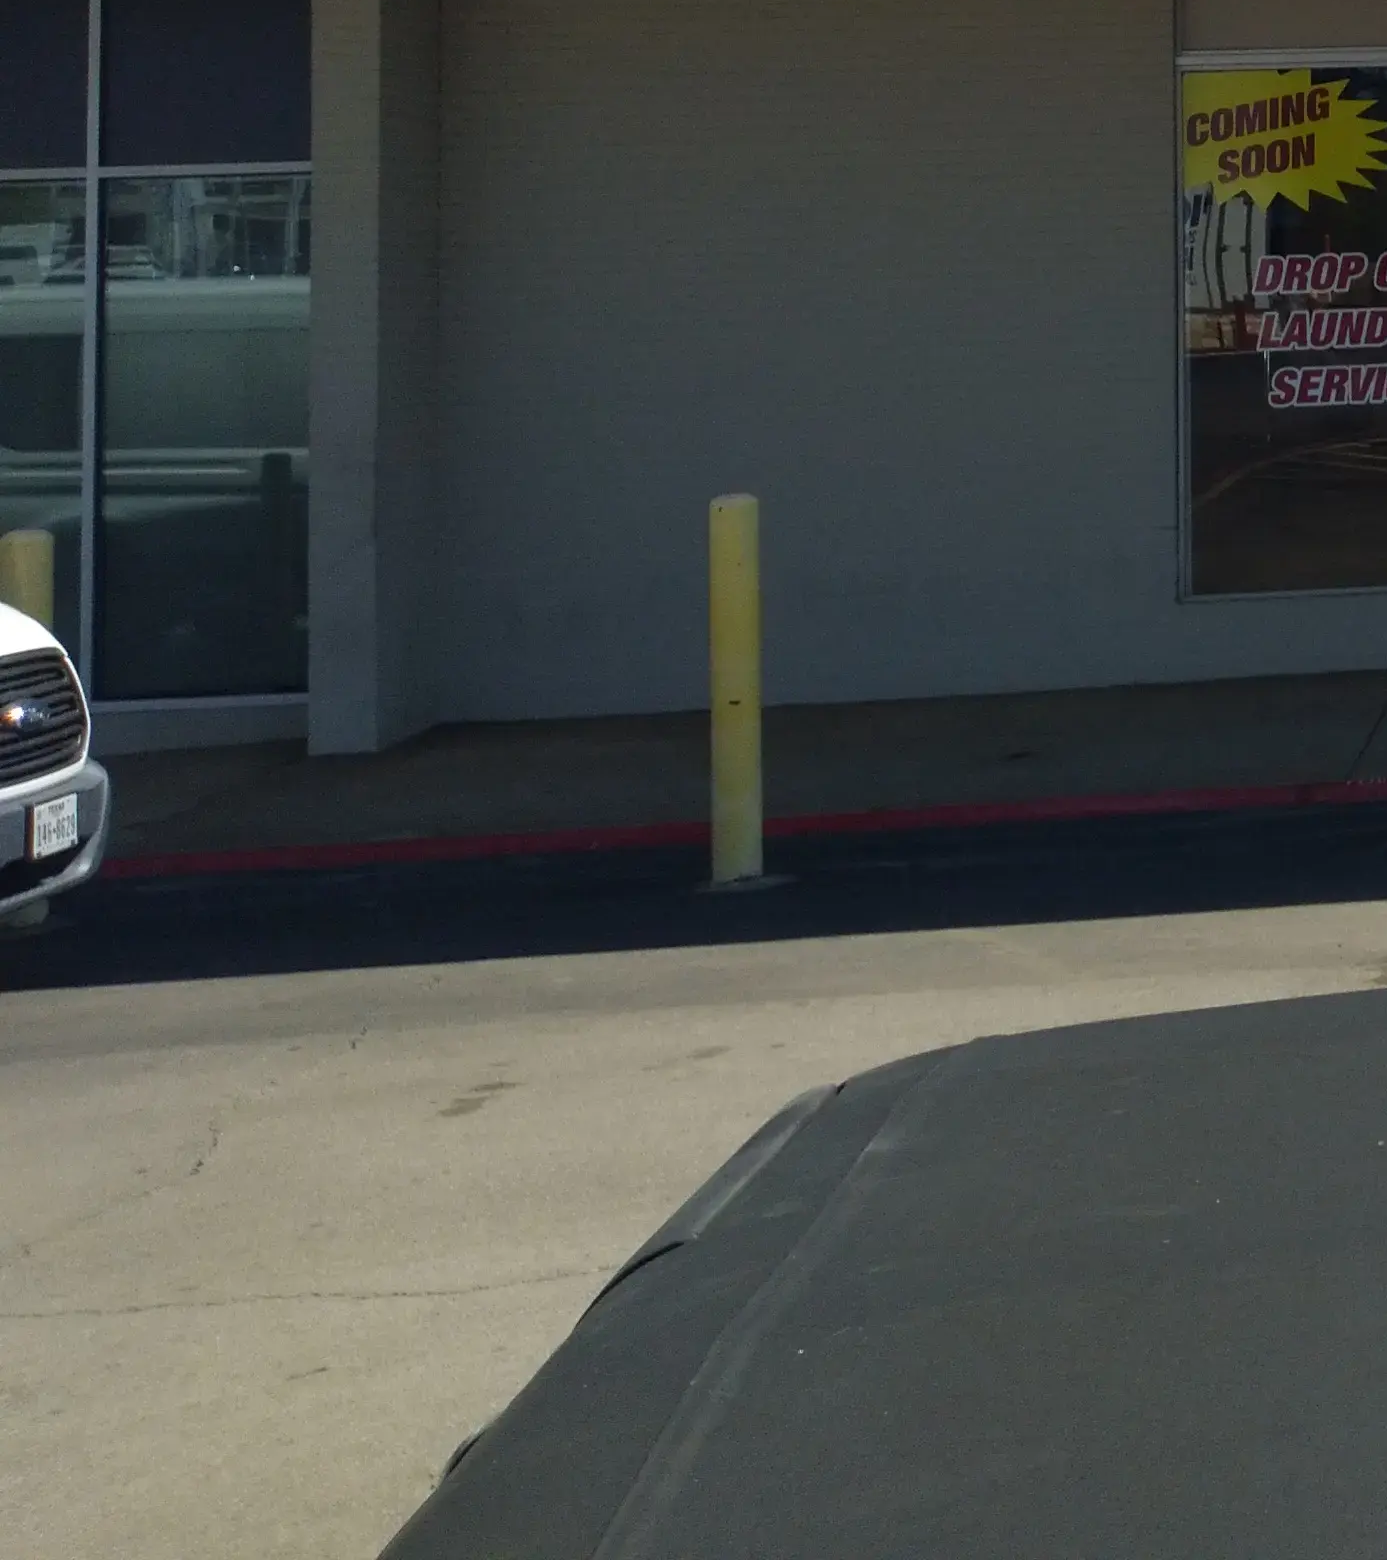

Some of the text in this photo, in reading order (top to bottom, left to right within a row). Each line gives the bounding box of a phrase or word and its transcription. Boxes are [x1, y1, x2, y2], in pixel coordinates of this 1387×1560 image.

[1186, 88, 1330, 147] COMING
[1217, 133, 1316, 184] SOON
[1253, 252, 1369, 296] DROP
